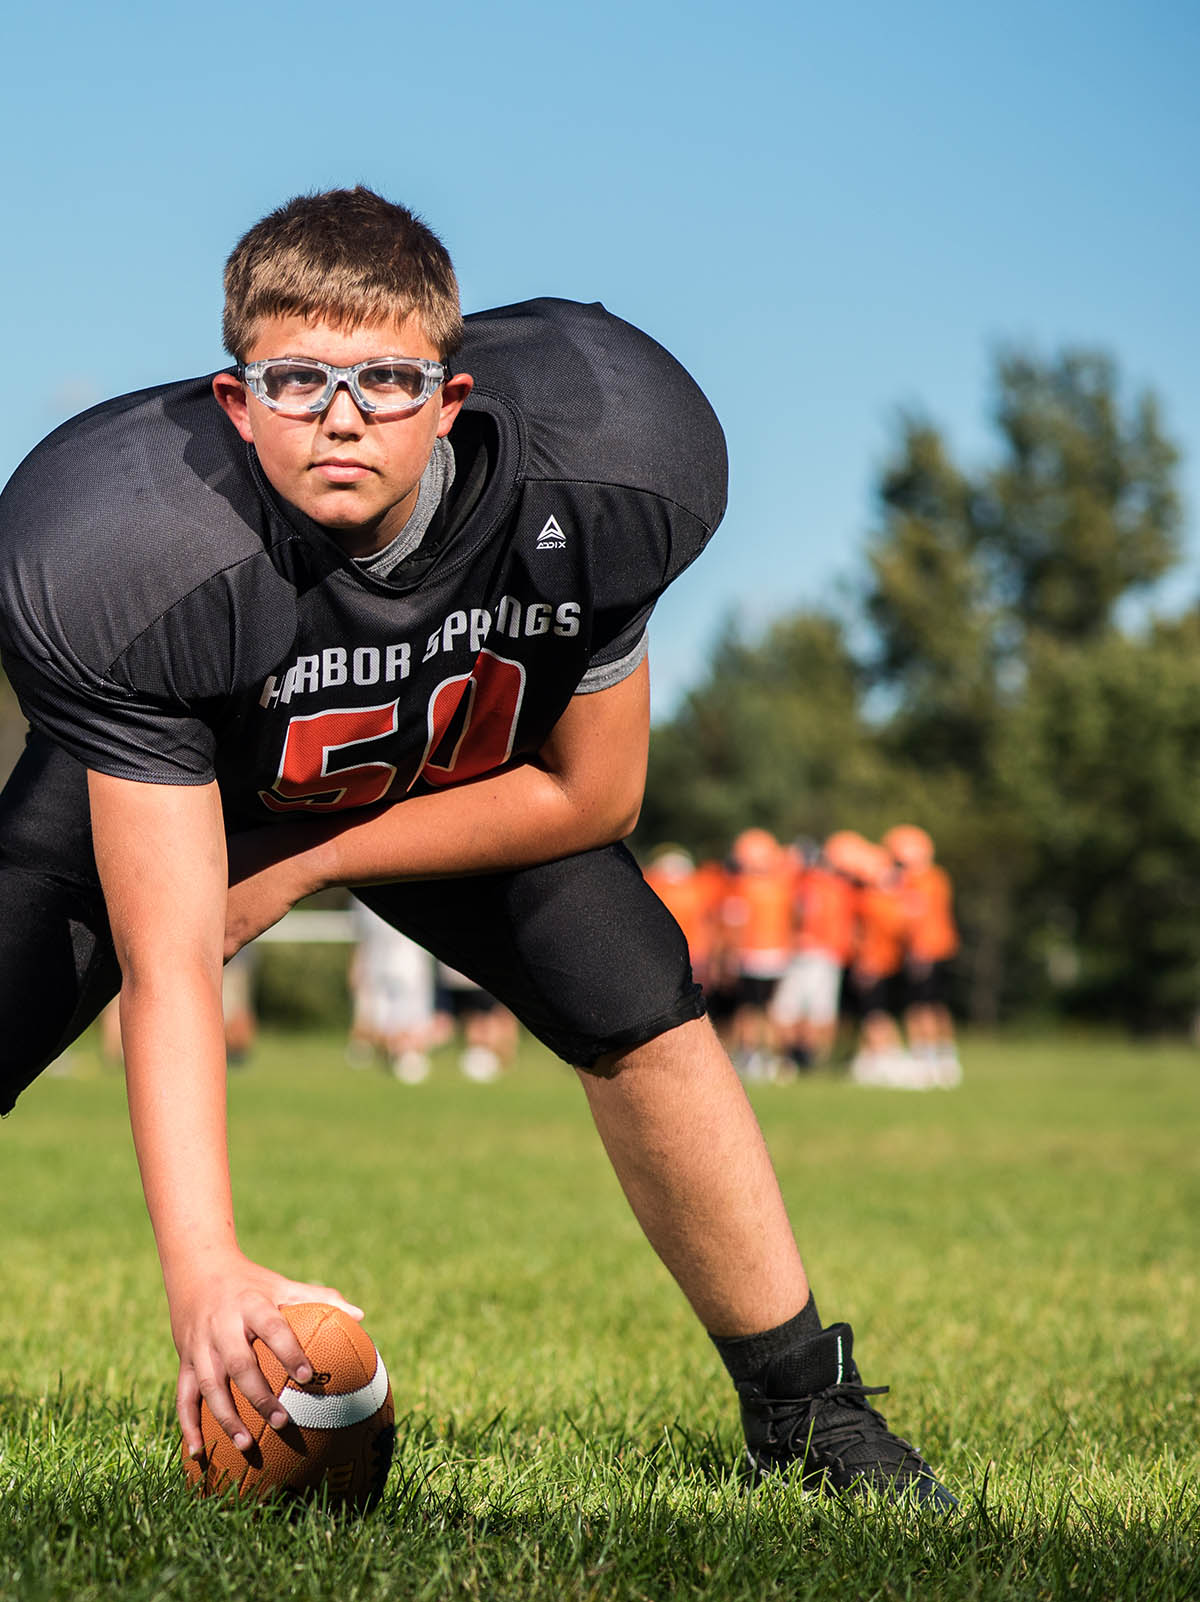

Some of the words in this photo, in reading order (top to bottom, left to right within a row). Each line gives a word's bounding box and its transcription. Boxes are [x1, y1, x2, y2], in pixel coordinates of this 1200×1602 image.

[536, 541, 567, 550] ADDIX
[258, 643, 412, 710] HARBOR
[421, 595, 582, 663] SPRNGS
[257, 647, 526, 812] 50
